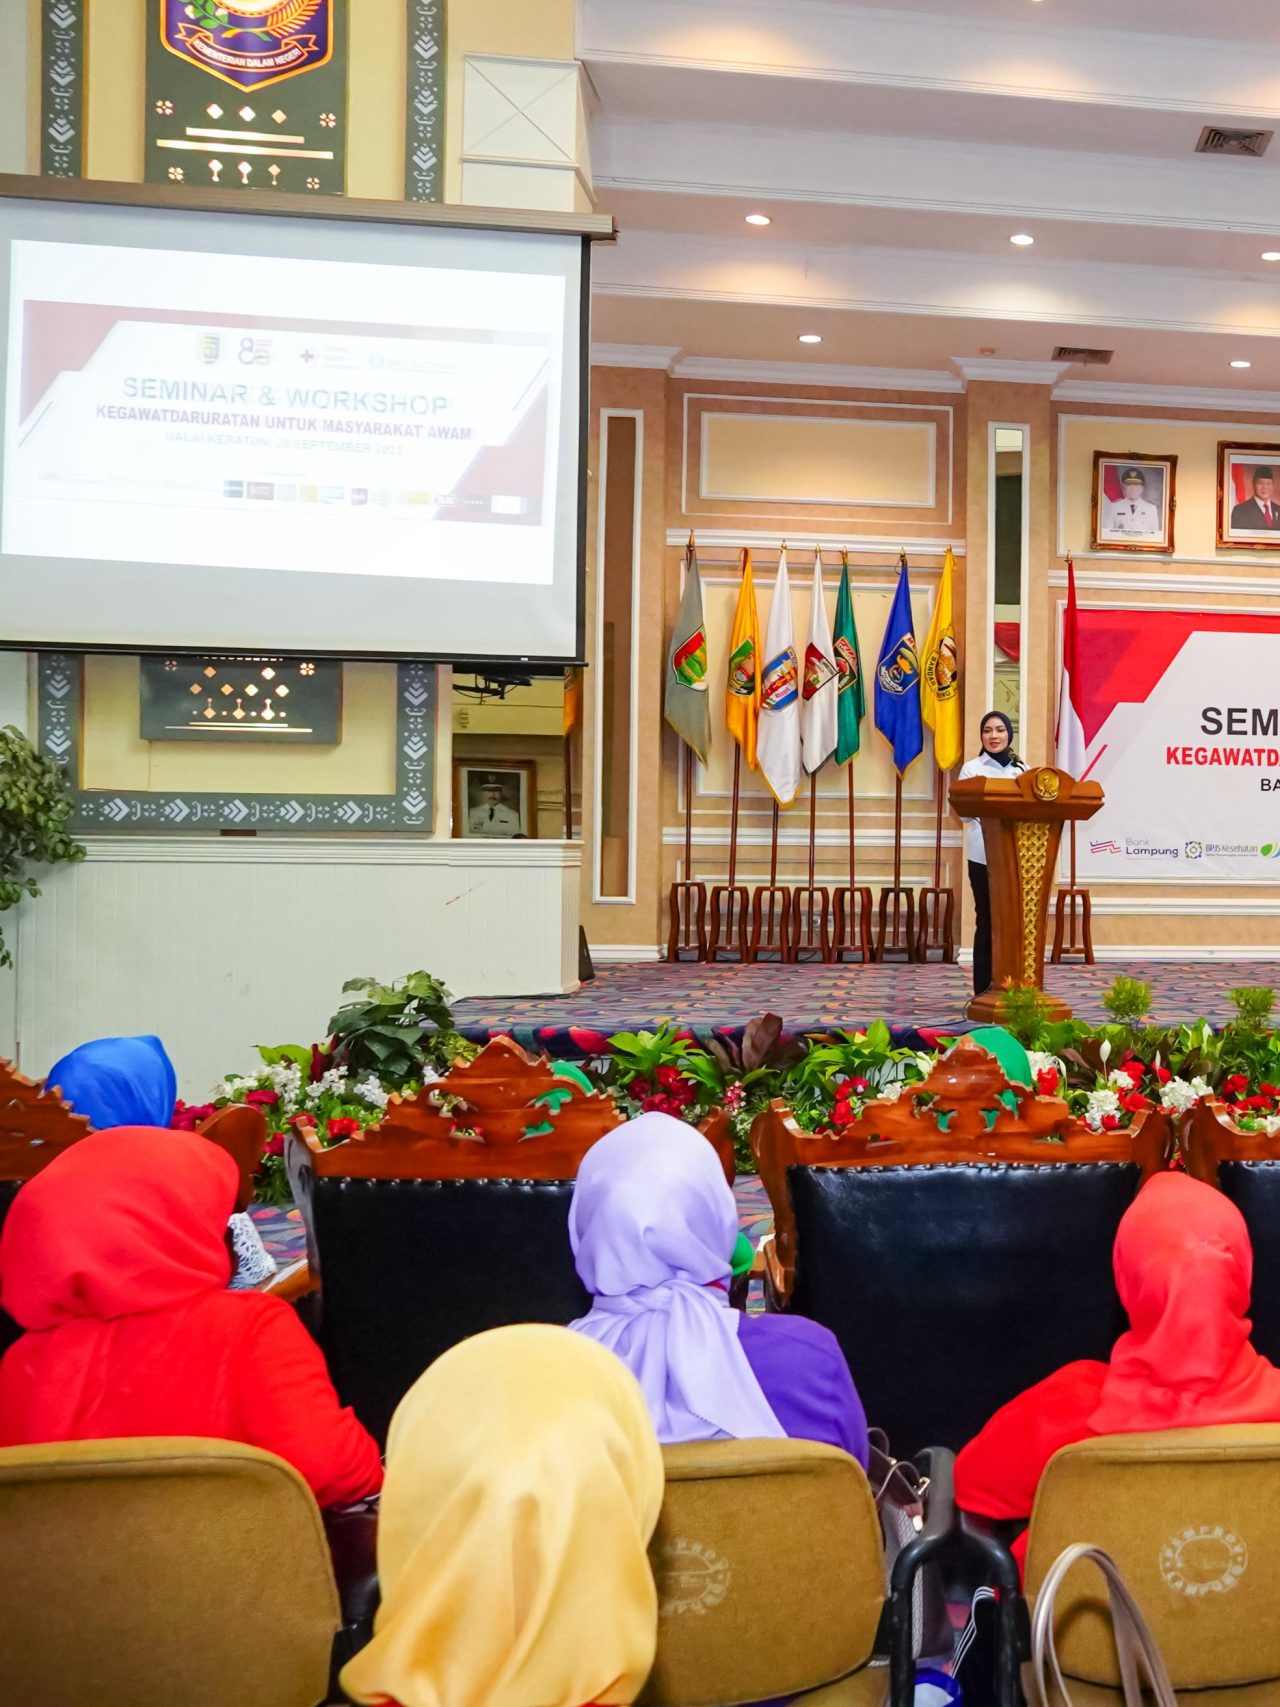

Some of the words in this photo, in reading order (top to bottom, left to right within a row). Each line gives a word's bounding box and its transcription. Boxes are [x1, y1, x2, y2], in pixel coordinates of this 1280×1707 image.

[246, 58, 275, 67] DALAM
[274, 48, 303, 66] NEGERI
[122, 376, 249, 405] SEMINAR
[258, 385, 277, 407] &
[286, 387, 449, 416] WORKSHOP
[96, 404, 260, 430] KEGAWATDARURATAN
[265, 415, 317, 432] UNTUK
[323, 419, 422, 438] MASYARAKAT
[427, 425, 472, 441] AWAM
[926, 655, 937, 687] BANDAR
[1125, 838, 1150, 847] Bank
[1205, 844, 1221, 853] BPJS
[1221, 844, 1258, 853] Kesehatan
[1126, 846, 1179, 859] Lampung
